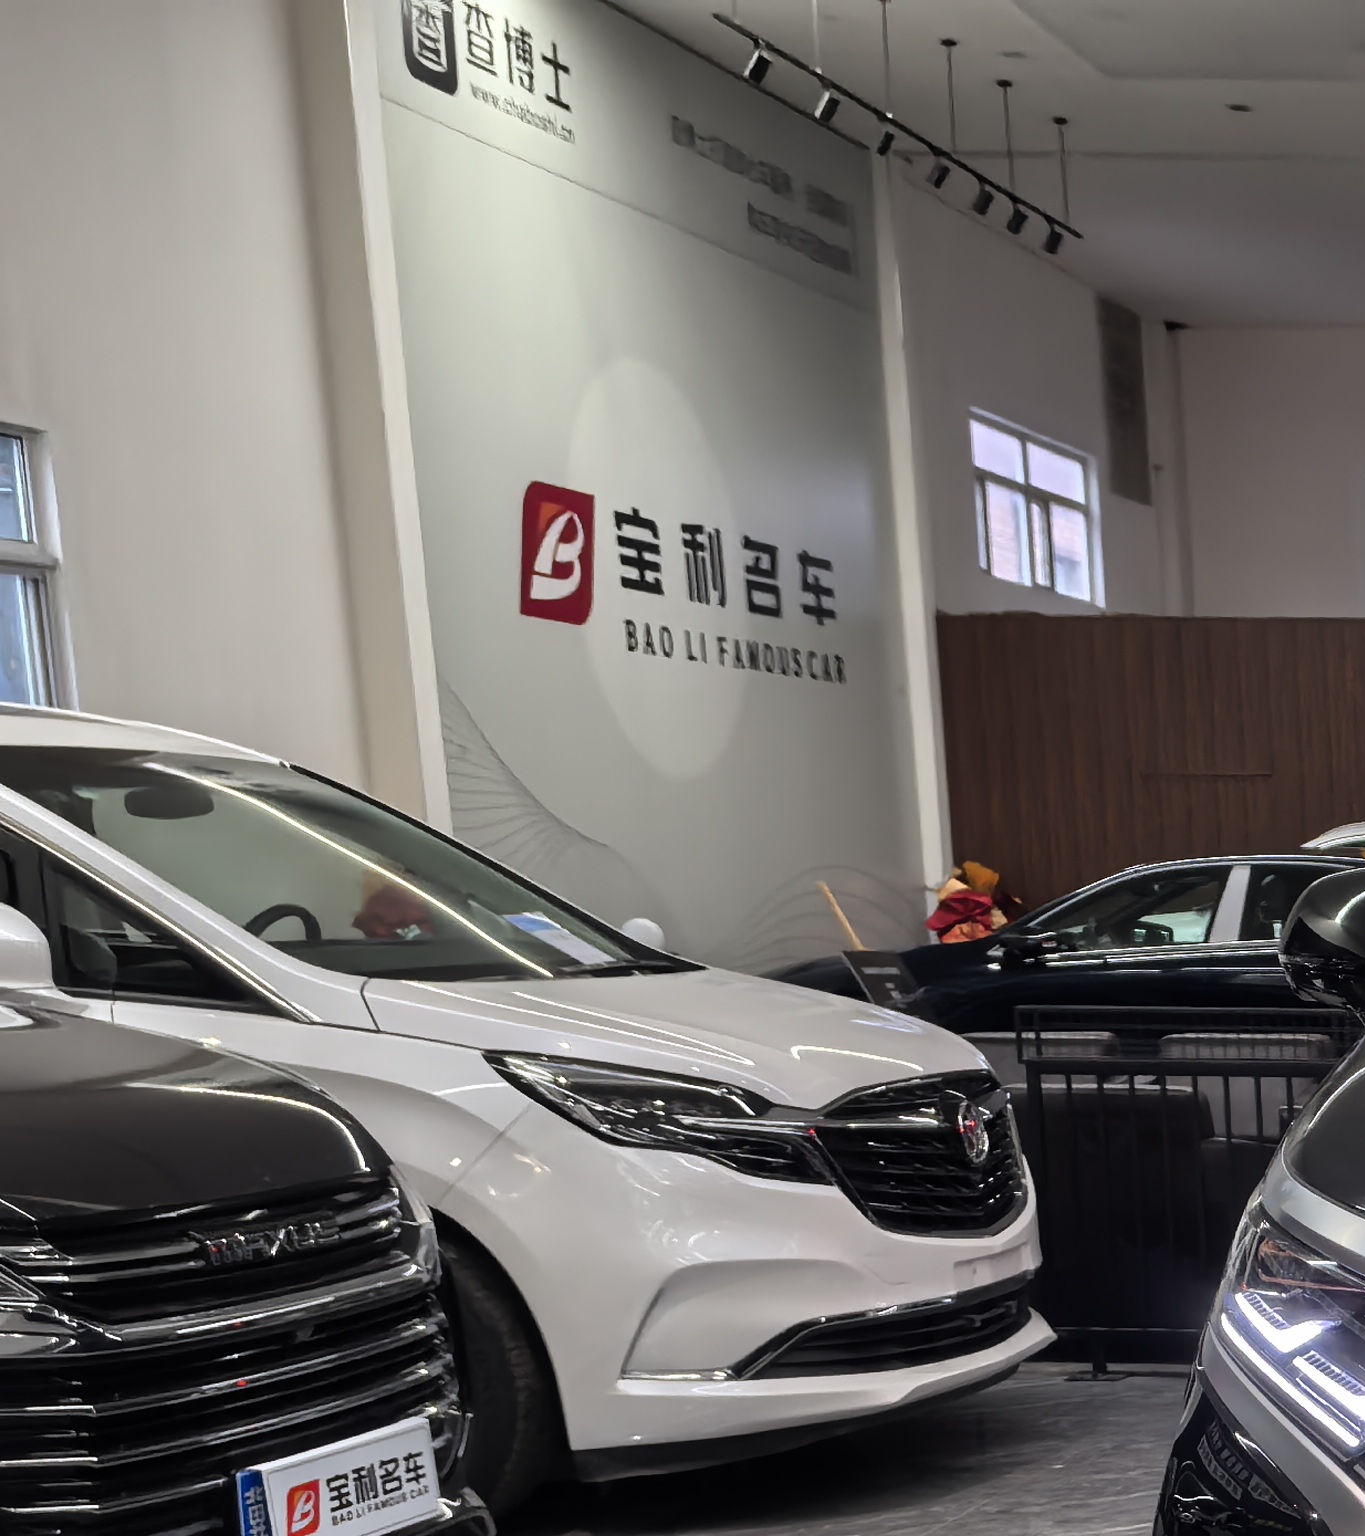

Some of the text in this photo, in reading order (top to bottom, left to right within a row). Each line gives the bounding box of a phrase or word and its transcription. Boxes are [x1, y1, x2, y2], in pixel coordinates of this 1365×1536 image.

[613, 506, 838, 626] 宝利名车
[623, 618, 674, 659] BAO
[683, 629, 708, 665] LI
[326, 1452, 427, 1512] 宝利名车
